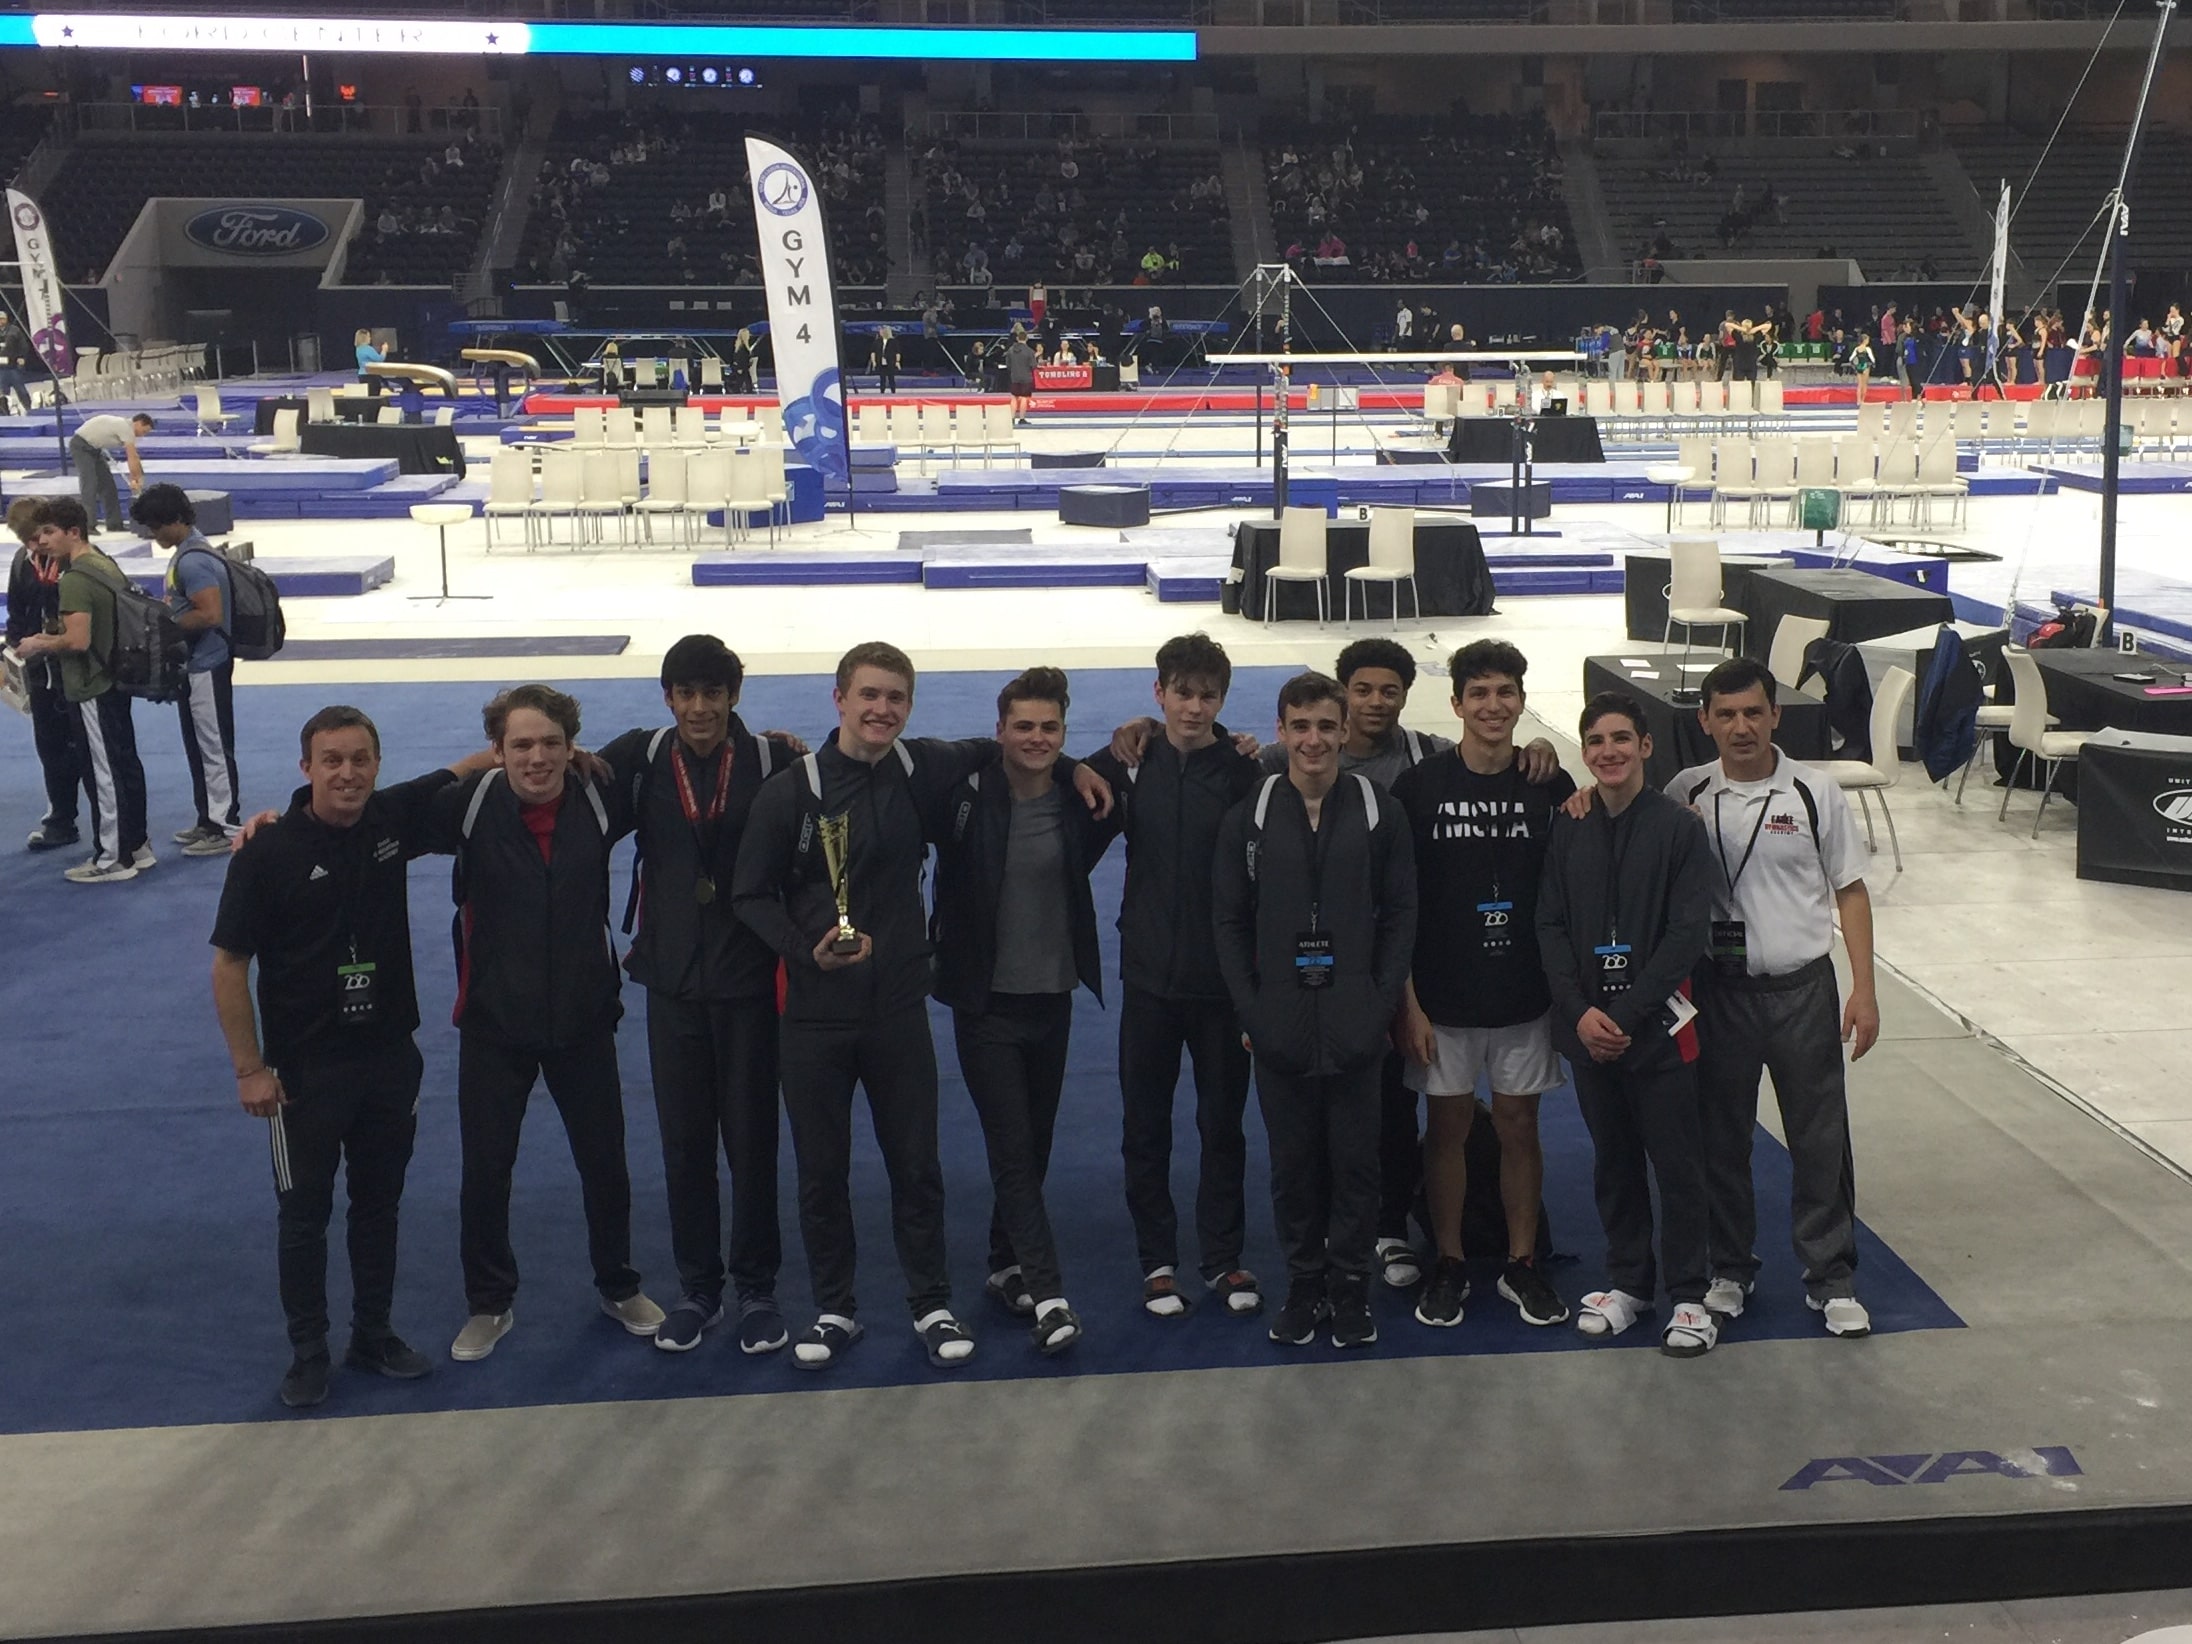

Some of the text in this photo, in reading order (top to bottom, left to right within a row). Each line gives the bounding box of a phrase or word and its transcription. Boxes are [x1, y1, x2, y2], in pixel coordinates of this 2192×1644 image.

[213, 211, 300, 248] Ford
[782, 229, 811, 306] GYM
[796, 323, 811, 344] 4
[1359, 507, 1368, 520] B
[2122, 632, 2135, 651] B
